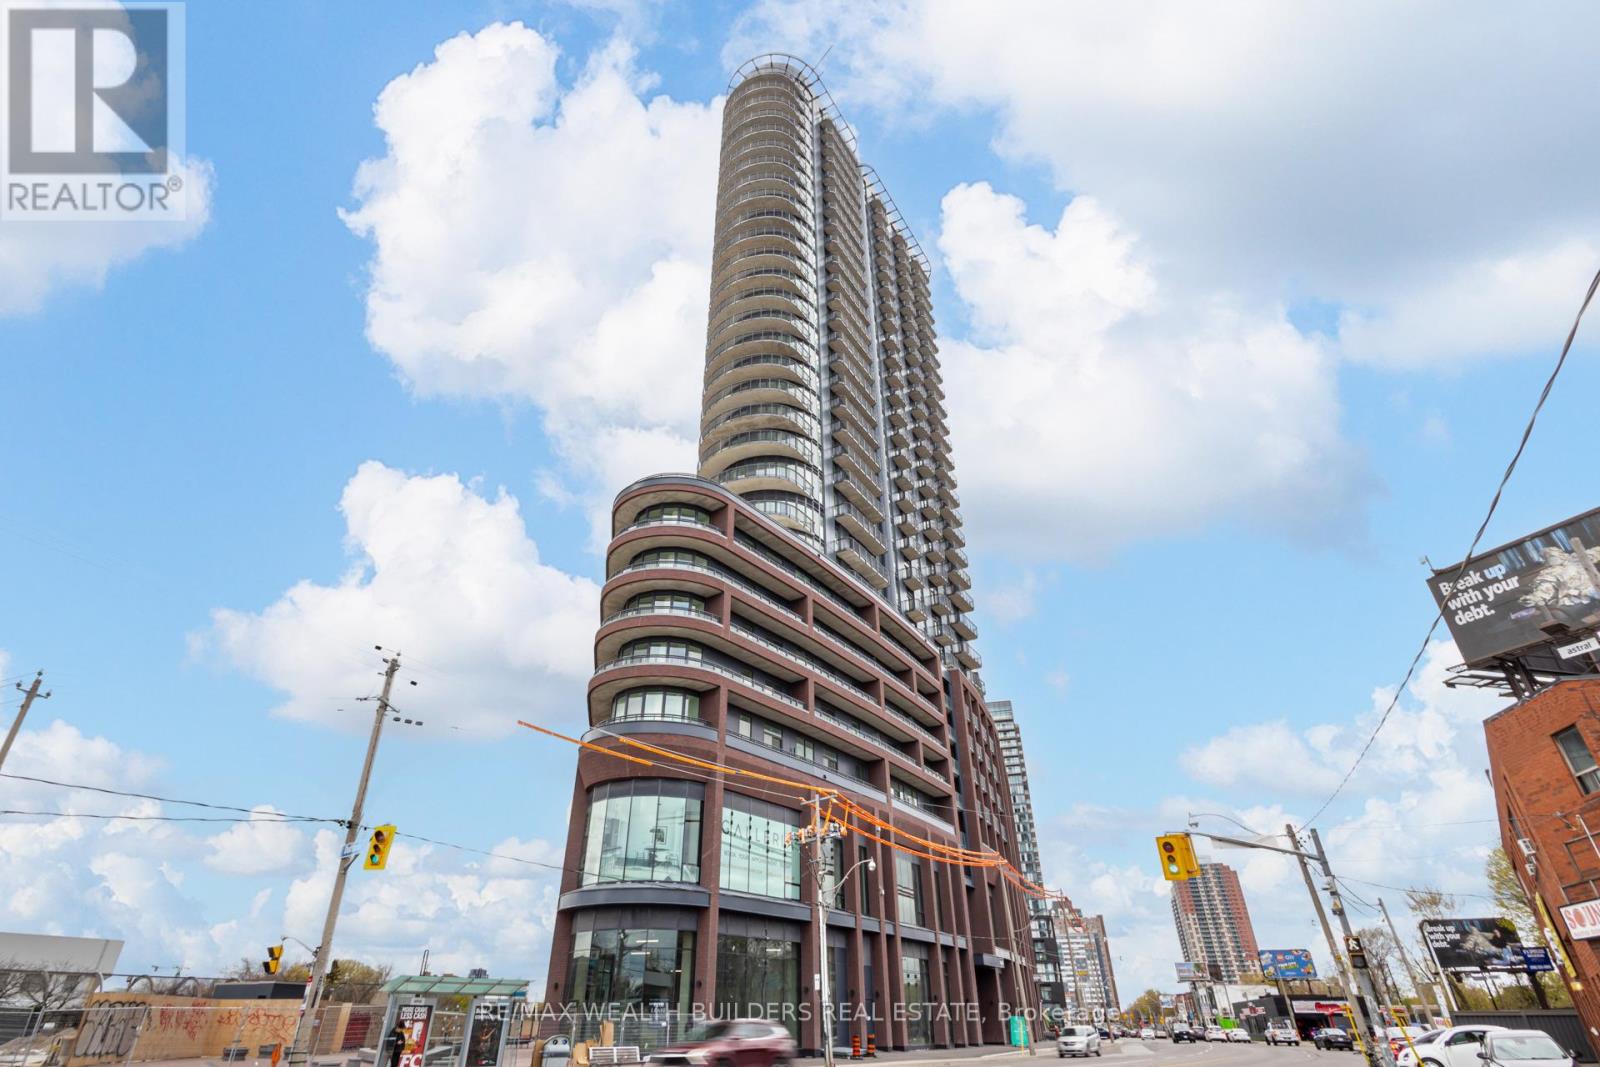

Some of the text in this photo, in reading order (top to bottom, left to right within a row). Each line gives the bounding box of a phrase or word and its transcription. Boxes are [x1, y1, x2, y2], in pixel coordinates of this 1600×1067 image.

[1483, 564, 1506, 580] up
[1447, 576, 1520, 610] with your
[1455, 604, 1496, 625] debt.
[1568, 642, 1592, 654] astral
[400, 1012, 413, 1020] LESS
[398, 1054, 424, 1067] FC
